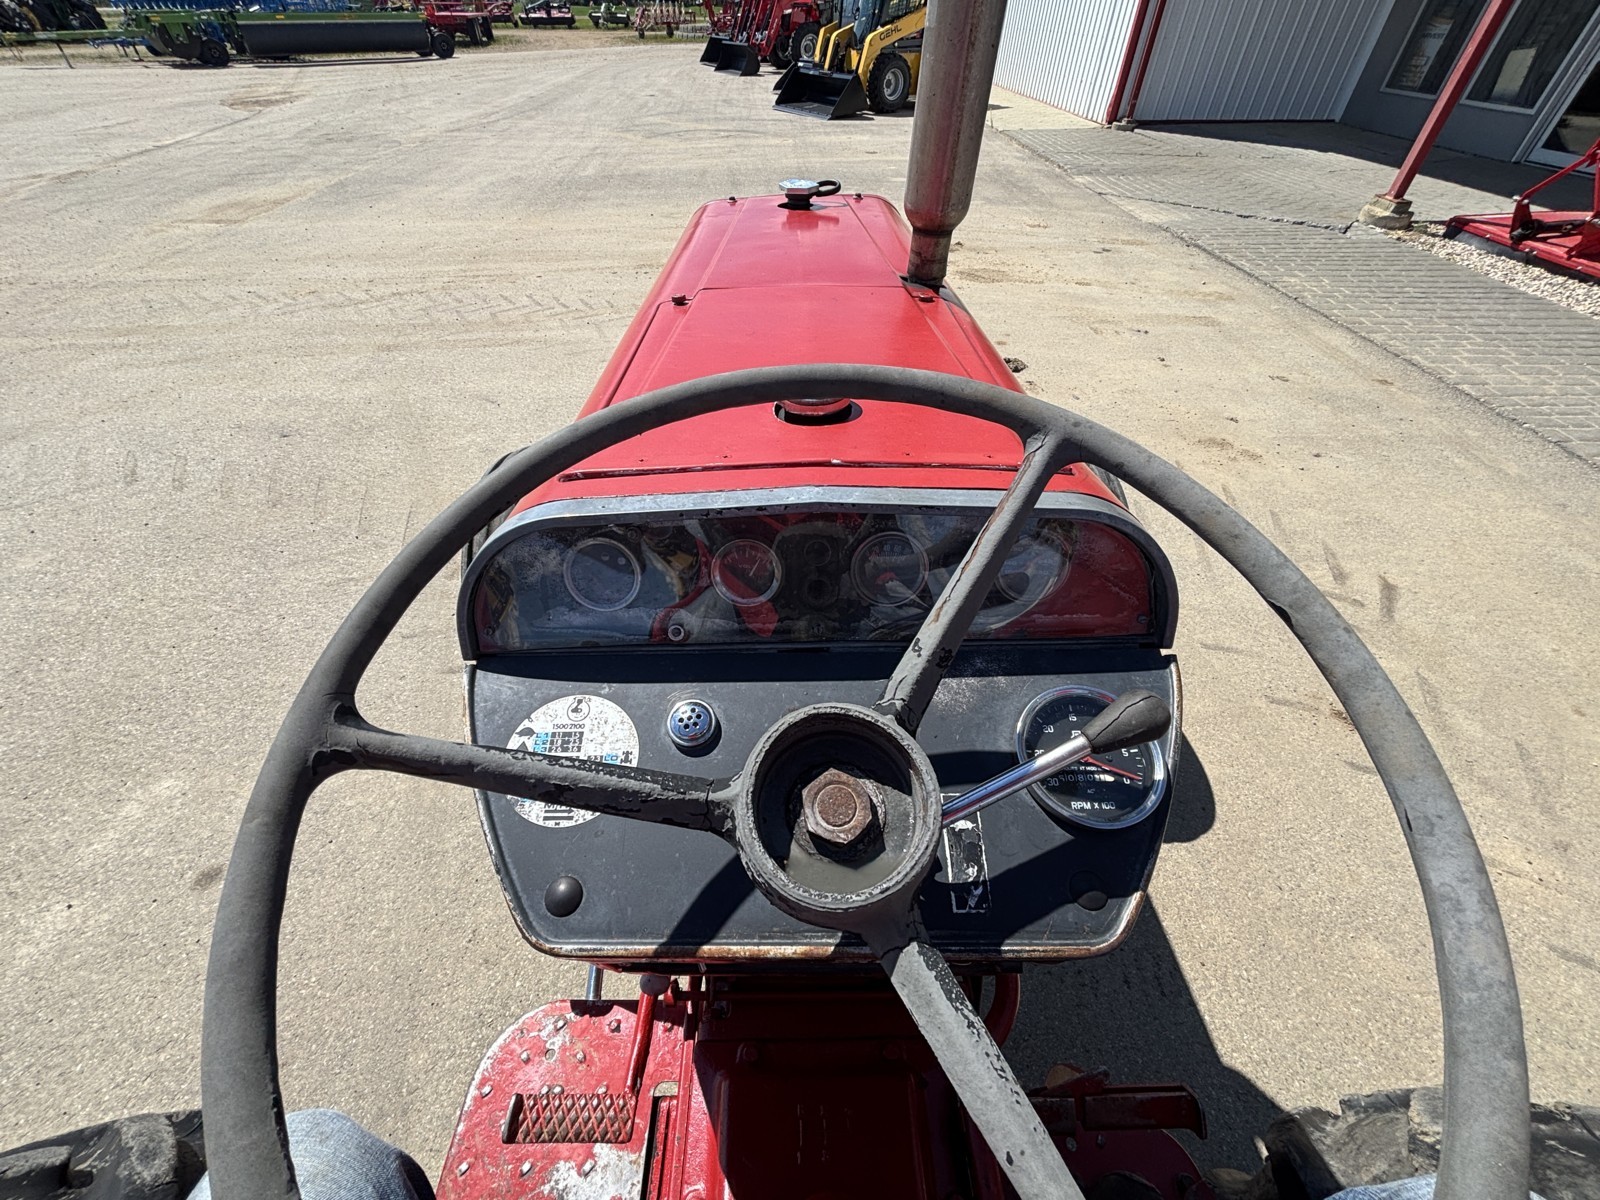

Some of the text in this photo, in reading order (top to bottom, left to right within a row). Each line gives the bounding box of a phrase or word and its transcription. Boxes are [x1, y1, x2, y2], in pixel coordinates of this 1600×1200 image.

[879, 25, 902, 41] GEHL
[1069, 713, 1077, 721] 15
[1042, 724, 1054, 733] 20
[1121, 748, 1129, 757] 5
[1047, 777, 1060, 787] 30
[1070, 801, 1092, 810] RPM
[1101, 801, 1116, 810] 100
